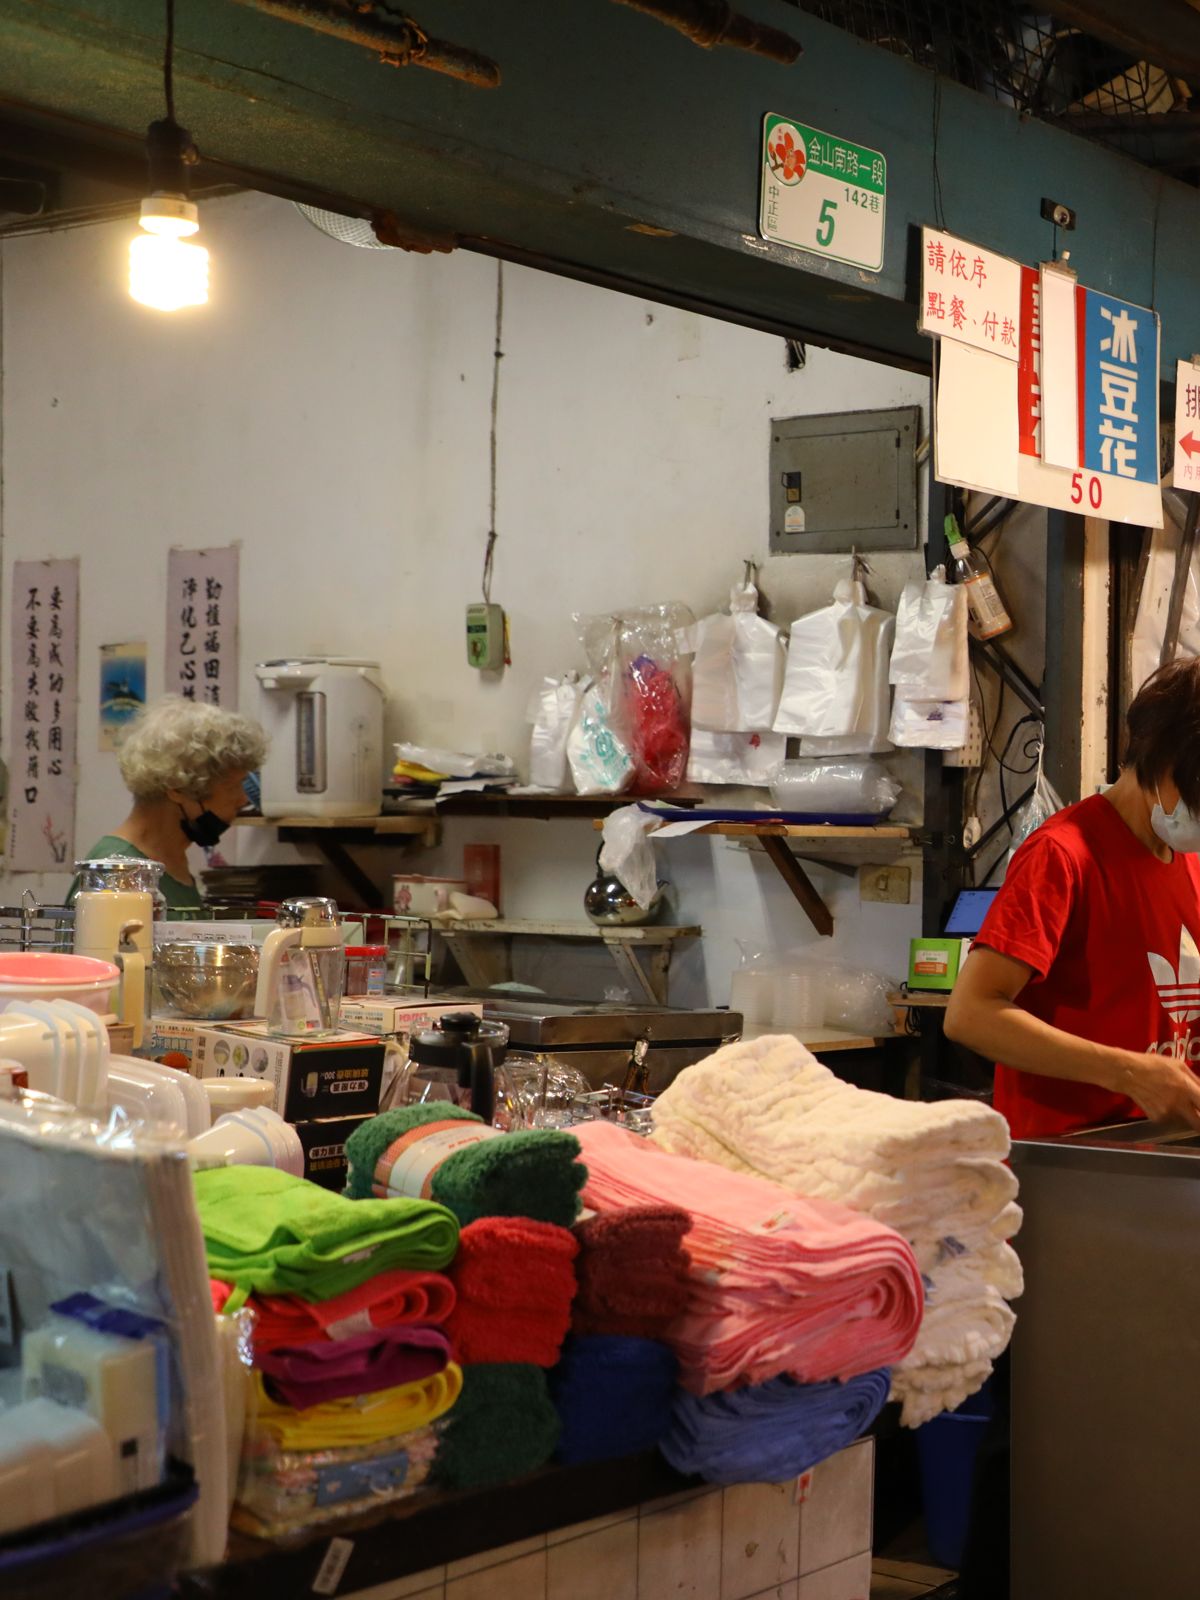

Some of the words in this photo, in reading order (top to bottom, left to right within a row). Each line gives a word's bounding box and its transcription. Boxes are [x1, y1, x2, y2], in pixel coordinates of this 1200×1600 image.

[808, 136, 884, 186] 金山南路一段
[767, 185, 780, 232] 中正區
[815, 198, 838, 247] 5
[844, 187, 881, 214] 142巷
[926, 240, 988, 290] 請依序
[926, 290, 1018, 349] 點餐、付款
[1099, 307, 1139, 480] 冰豆花
[1070, 472, 1103, 510] 50
